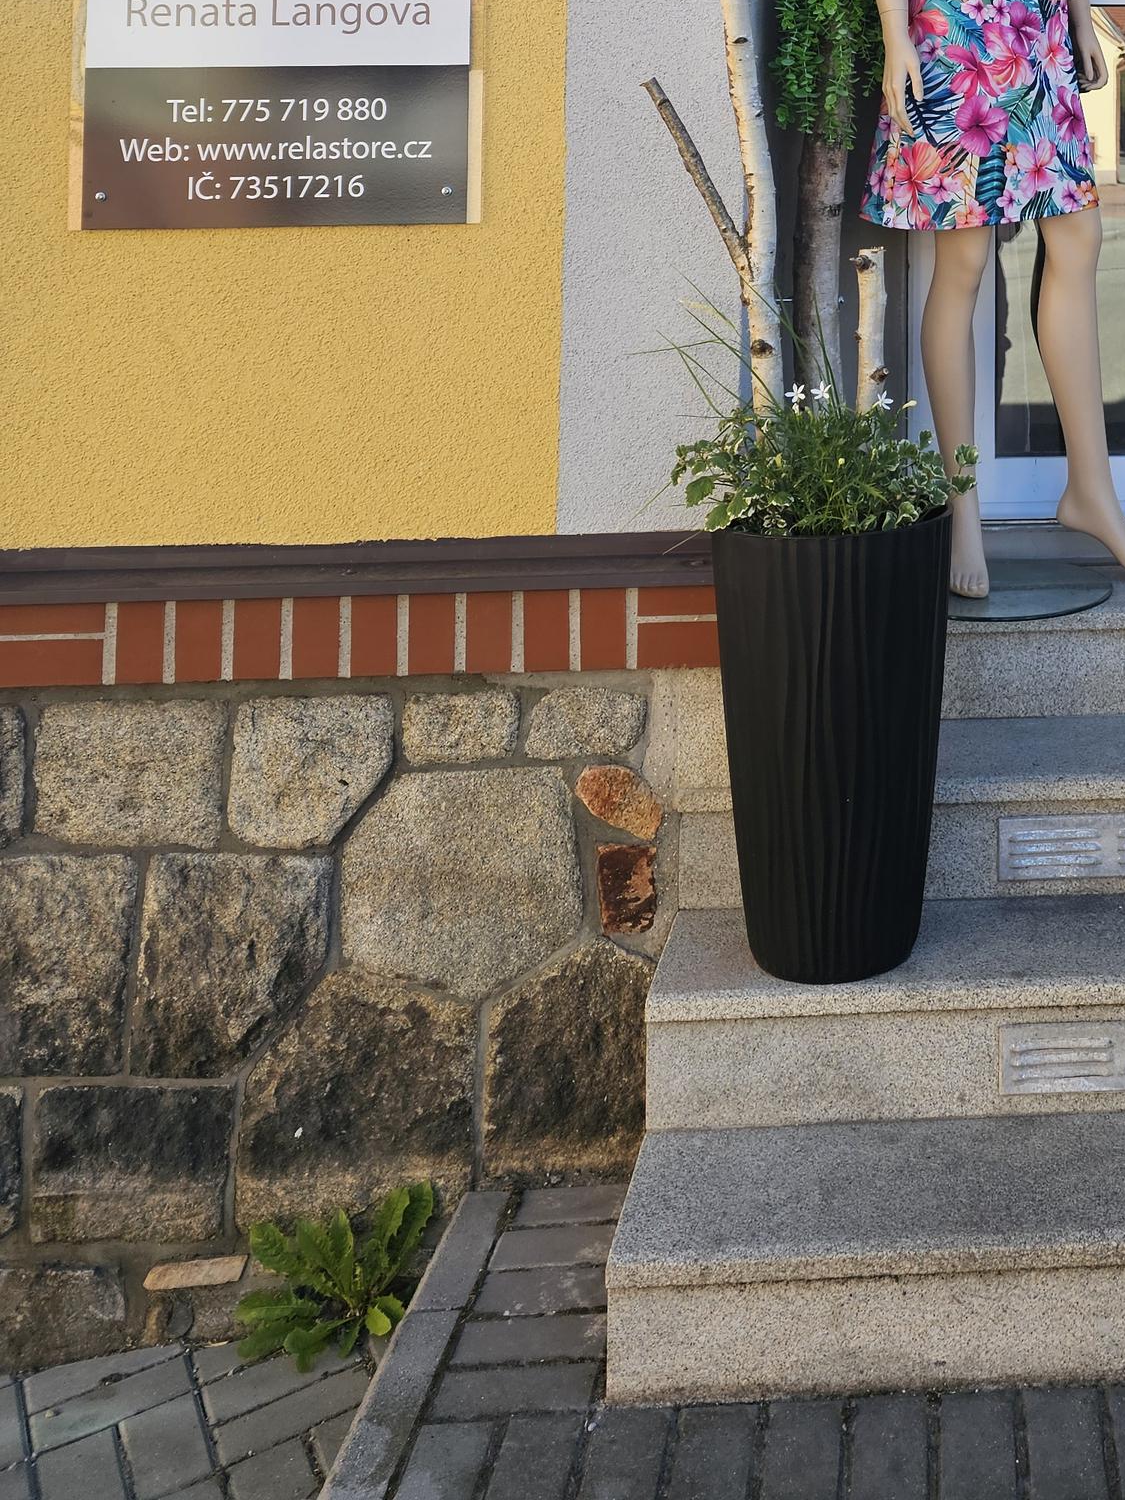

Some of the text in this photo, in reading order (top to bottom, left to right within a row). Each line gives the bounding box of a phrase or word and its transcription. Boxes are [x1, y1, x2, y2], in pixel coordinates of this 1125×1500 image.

[167, 97, 387, 122] Tel: 775 719 880
[119, 136, 432, 161] Web: www.relastore.cz
[188, 172, 365, 200] IČ: 73517216
